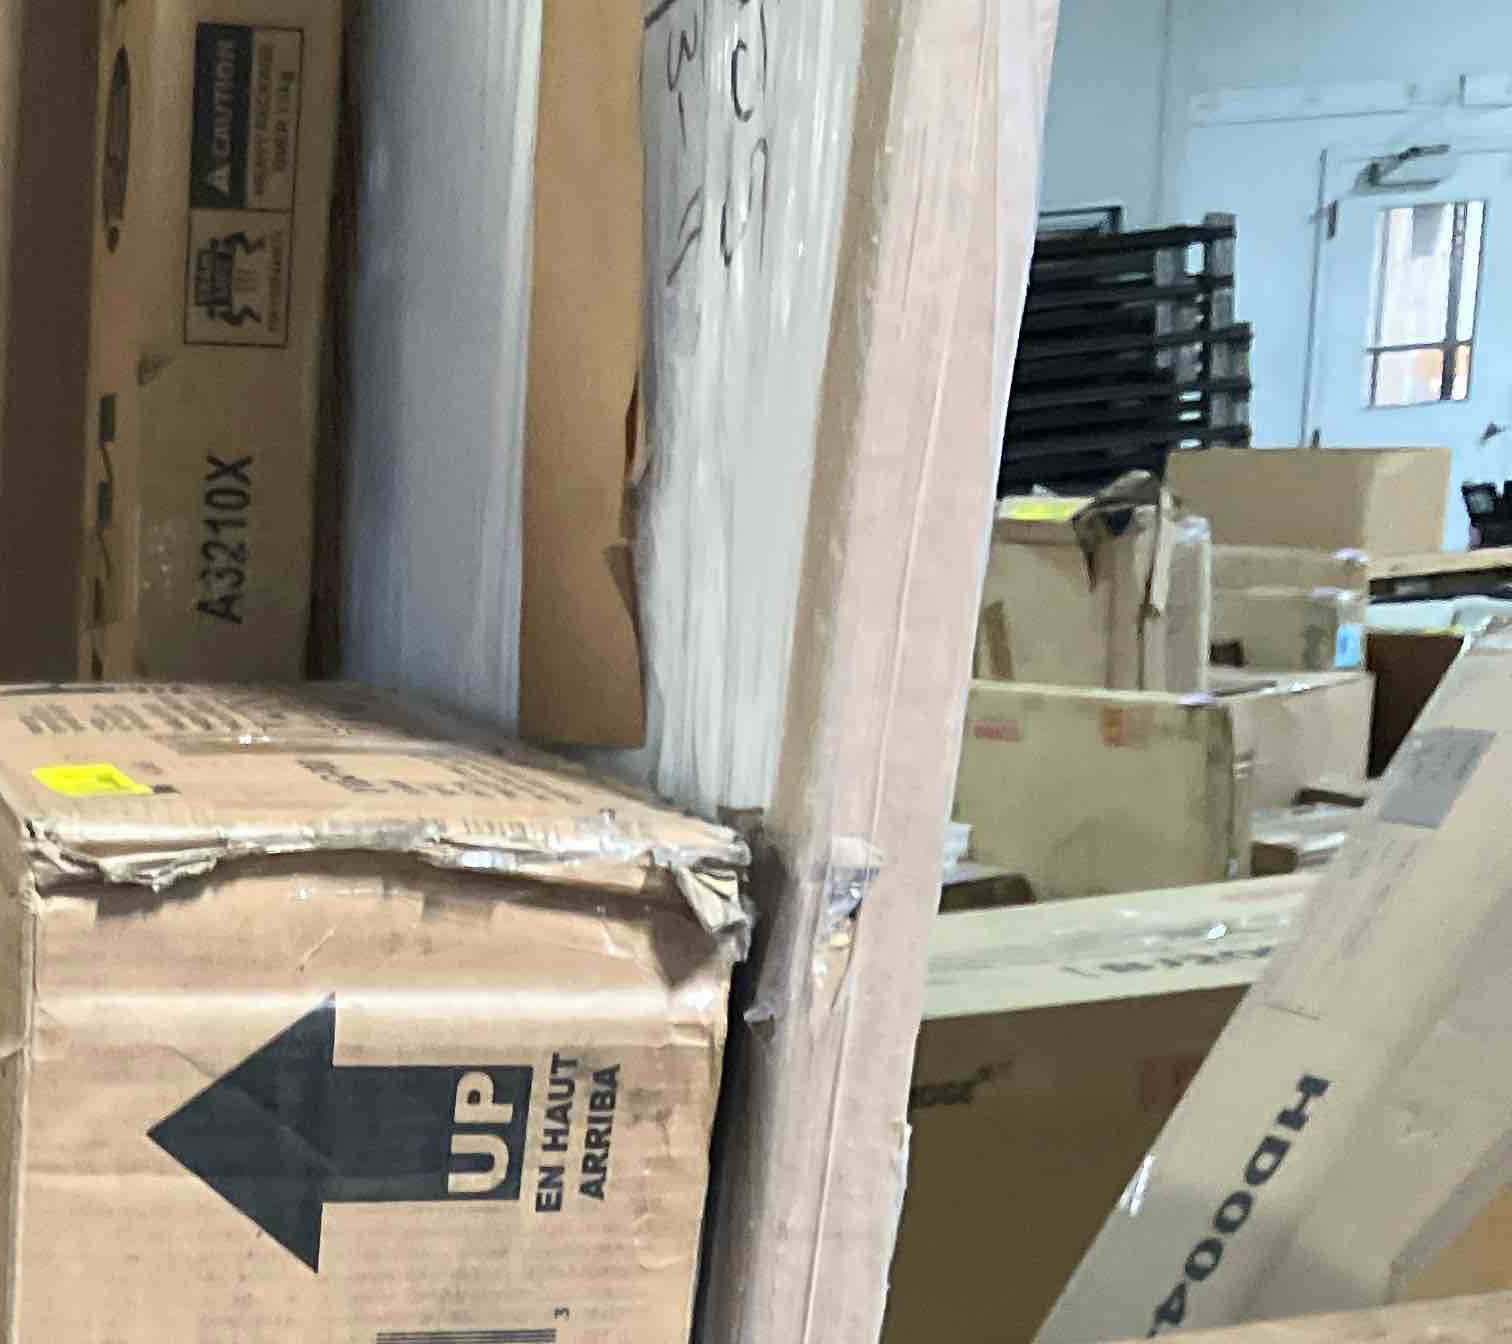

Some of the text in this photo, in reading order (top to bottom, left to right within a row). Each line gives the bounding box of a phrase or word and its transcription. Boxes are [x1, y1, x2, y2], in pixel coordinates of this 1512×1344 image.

[197, 454, 253, 626] A3210X
[446, 1070, 515, 1194] UP
[534, 1051, 578, 1213] EN HAUT
[578, 1062, 621, 1201] ARRIBA
[553, 1305, 571, 1321] 3
